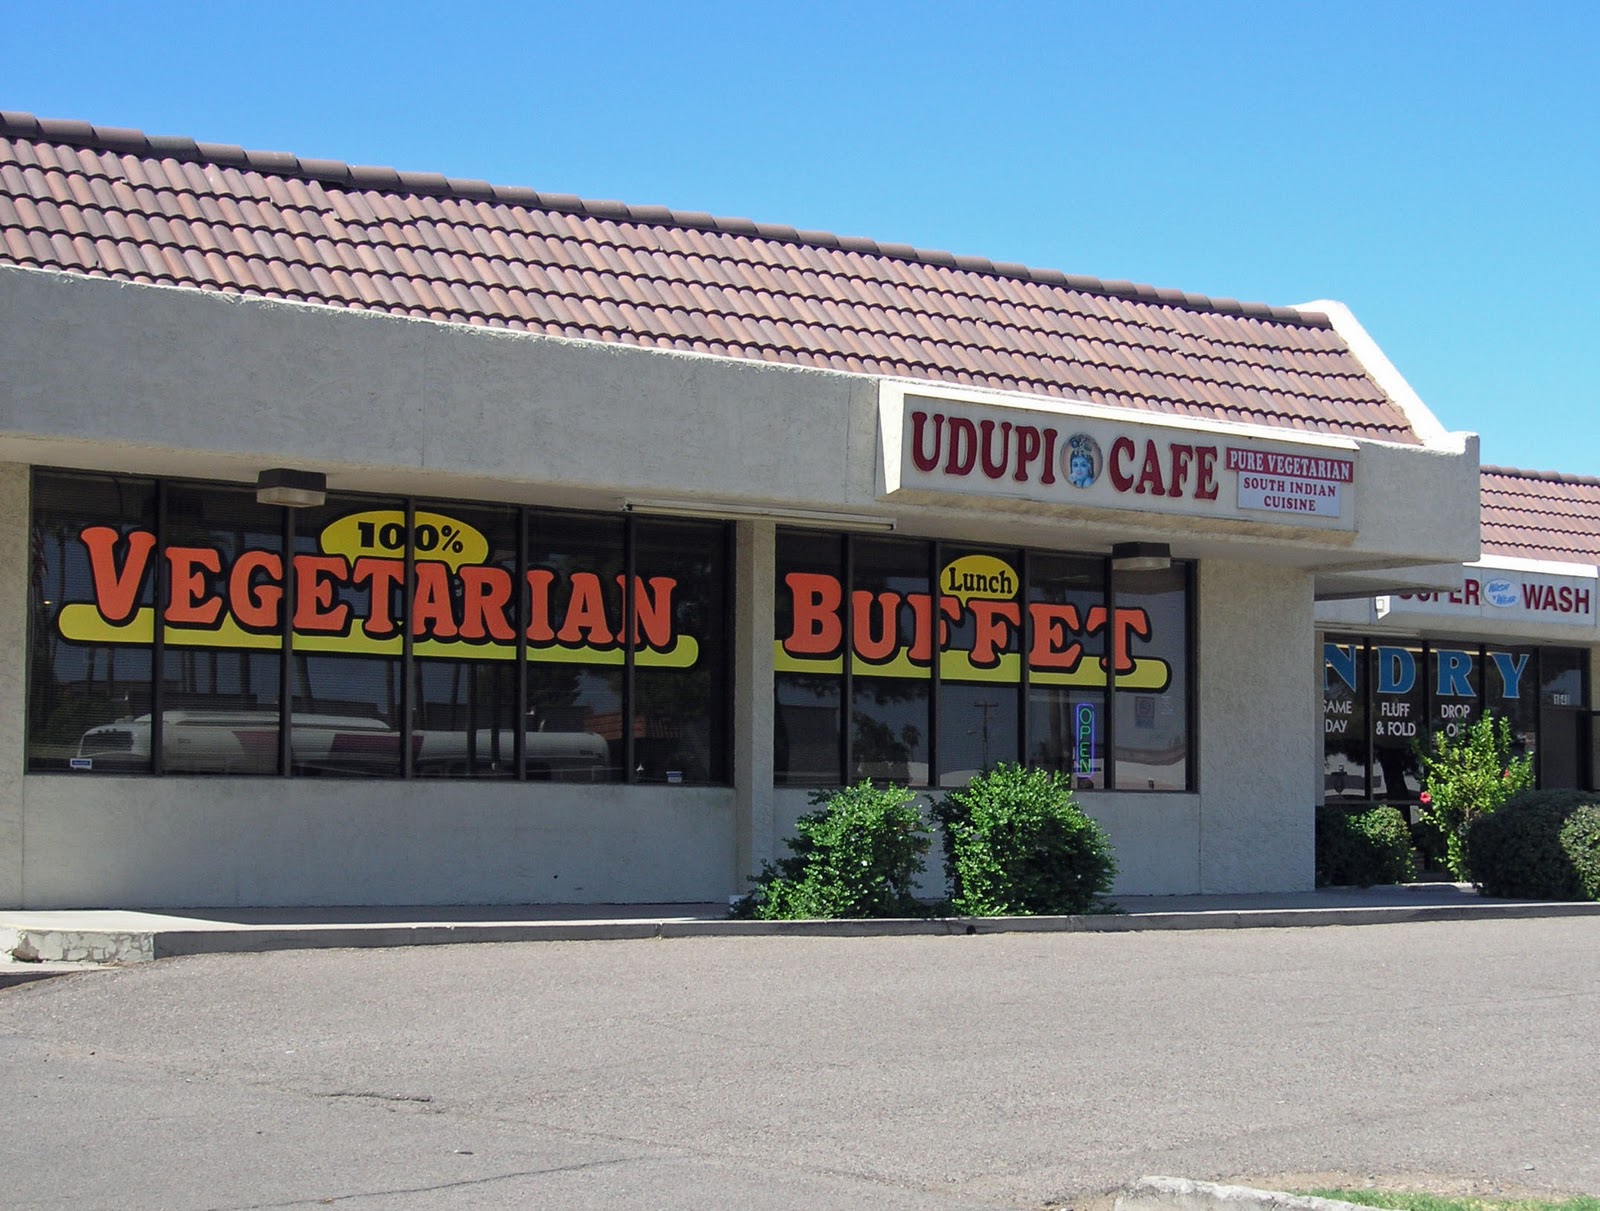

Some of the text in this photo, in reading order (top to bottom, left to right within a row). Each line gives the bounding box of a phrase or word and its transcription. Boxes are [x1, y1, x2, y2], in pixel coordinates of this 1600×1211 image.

[911, 411, 1219, 501] UDUPI CAFE
[1230, 450, 1350, 481] PURE VEGETARIAN
[1243, 477, 1337, 497] SOUTH INDIAN
[1263, 495, 1317, 512] CUISINE
[357, 521, 464, 554] 100%
[80, 526, 677, 648] VEGETARIAN
[948, 566, 1013, 595] Lunch
[1522, 583, 1590, 614] WASH
[784, 572, 1149, 672] BUFFET
[1381, 702, 1411, 718] FLUFF
[1441, 704, 1471, 719] DROP
[1079, 707, 1093, 774] OPEN
[1325, 719, 1348, 734] DAY
[1375, 721, 1417, 736] & FOLD
